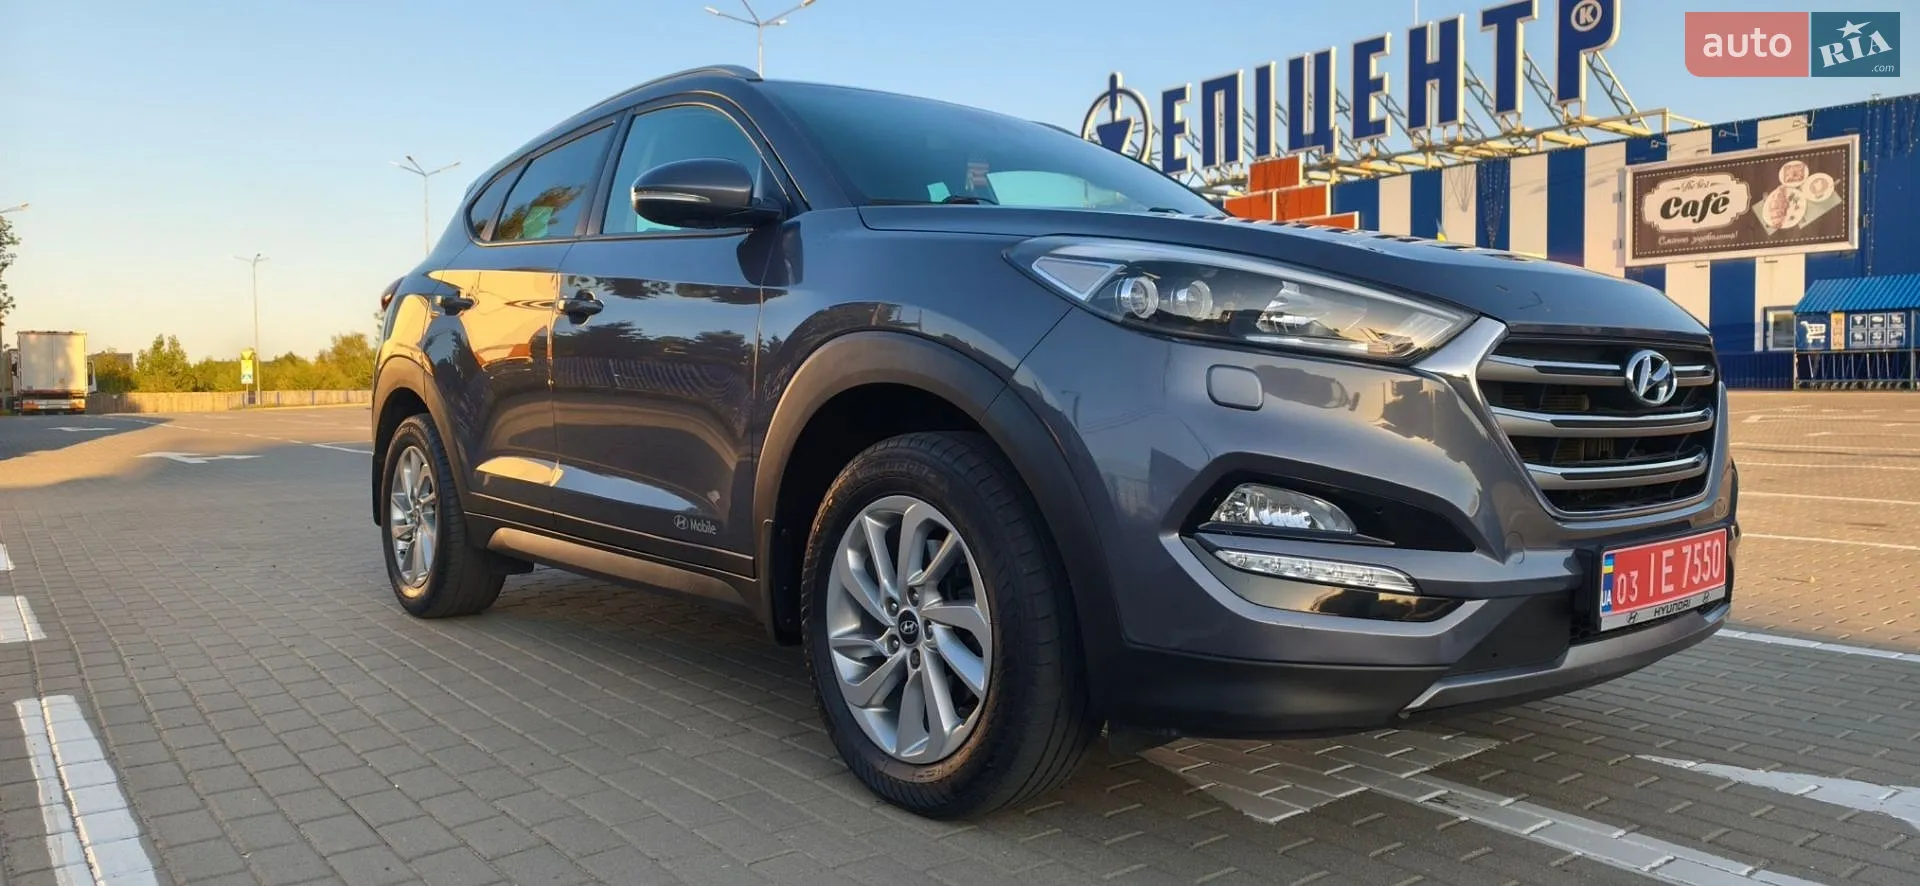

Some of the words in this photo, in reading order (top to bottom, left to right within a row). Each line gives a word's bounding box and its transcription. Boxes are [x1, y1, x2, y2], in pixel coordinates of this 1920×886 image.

[1160, 0, 1621, 176] ЕПІЦЕНТР
[1660, 190, 1730, 223] Café
[690, 518, 717, 535] Mobile
[1616, 570, 1639, 604] 03
[1648, 548, 1675, 597] IE
[1681, 539, 1721, 588] 7550
[1601, 589, 1612, 607] UA
[1653, 599, 1691, 617] HYUNDAI
